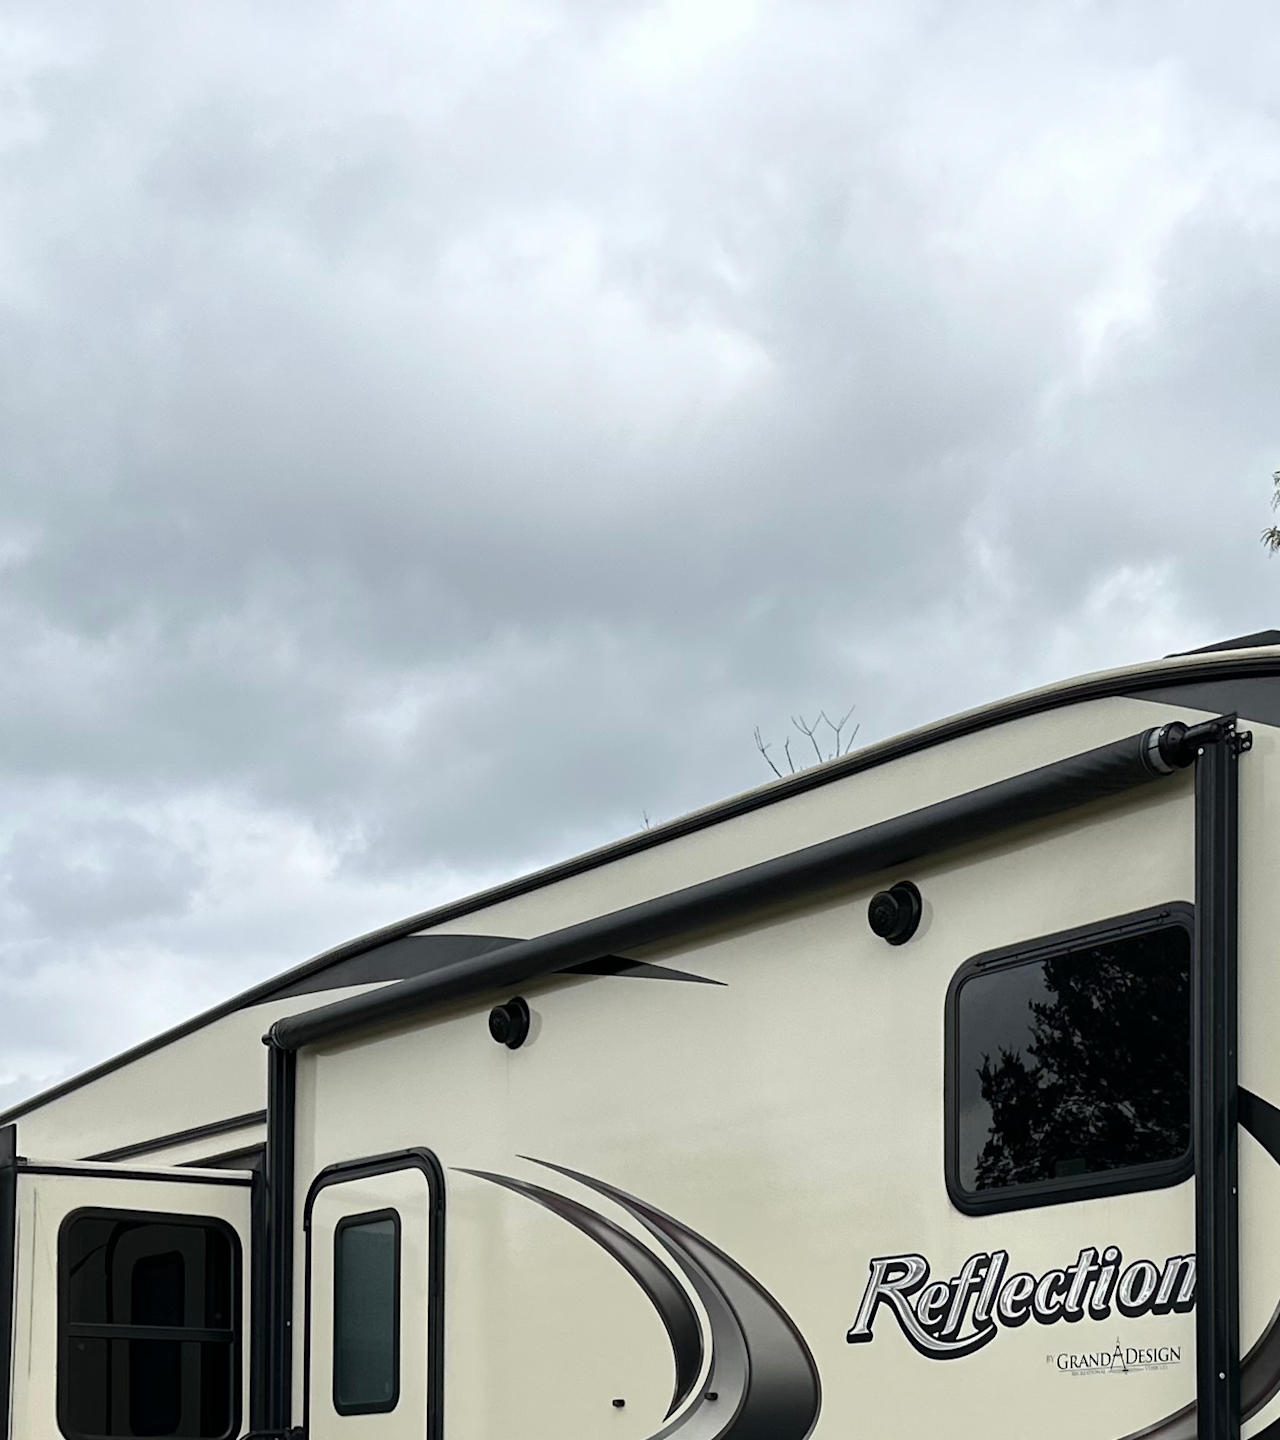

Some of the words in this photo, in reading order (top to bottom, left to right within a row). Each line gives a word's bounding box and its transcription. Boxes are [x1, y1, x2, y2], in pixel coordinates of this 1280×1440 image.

[846, 1245, 1197, 1361] Reflection
[1056, 1352, 1112, 1370] GRAND
[1125, 1346, 1182, 1365] DESIGN
